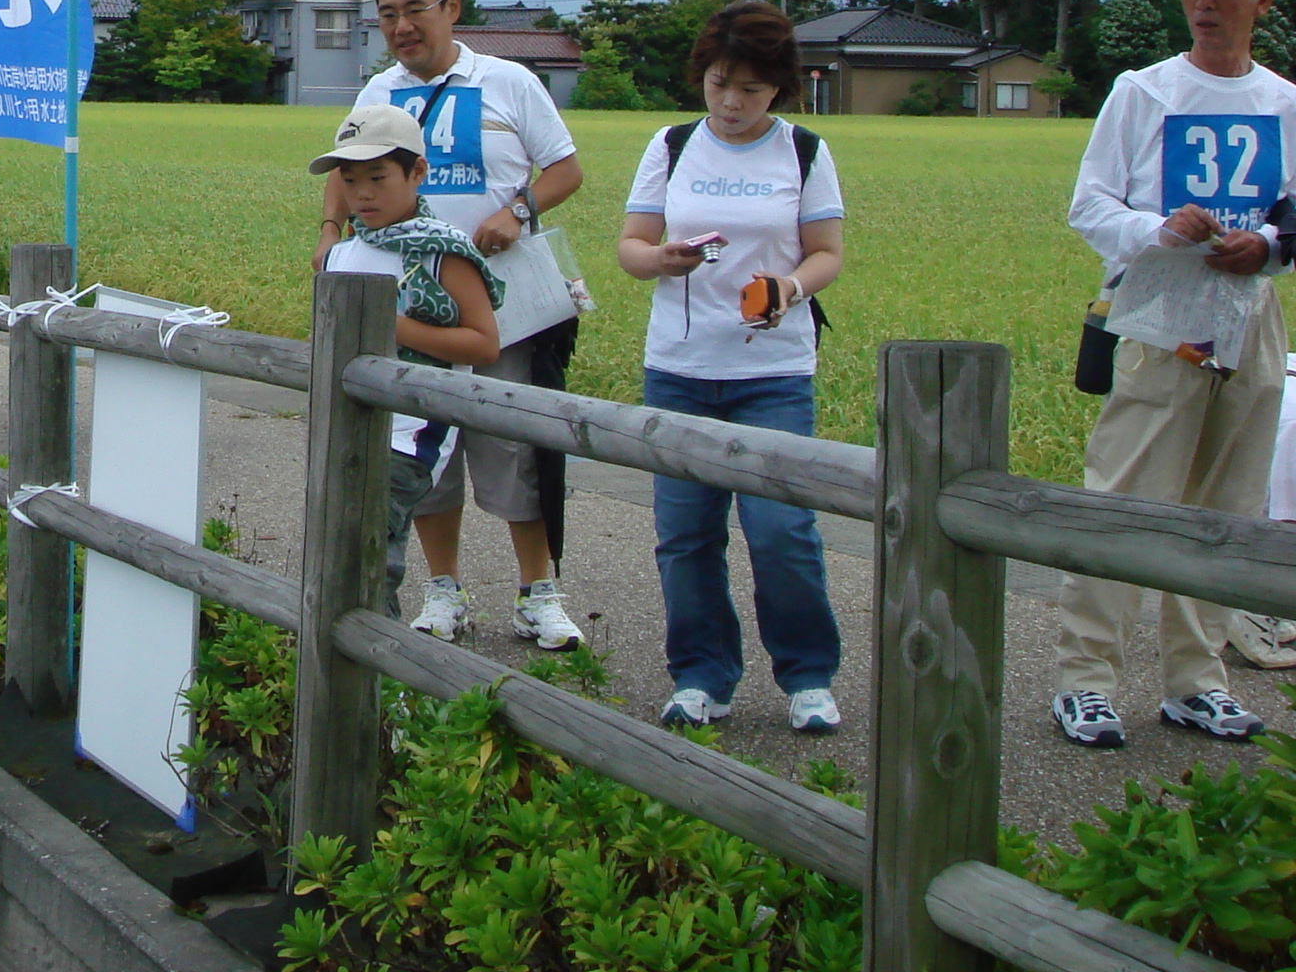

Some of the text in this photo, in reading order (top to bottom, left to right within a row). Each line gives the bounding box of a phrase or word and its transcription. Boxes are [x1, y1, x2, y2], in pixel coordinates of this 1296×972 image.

[1186, 124, 1259, 198] 32
[421, 163, 482, 186] 七ヶ用水
[690, 177, 774, 197] adidas
